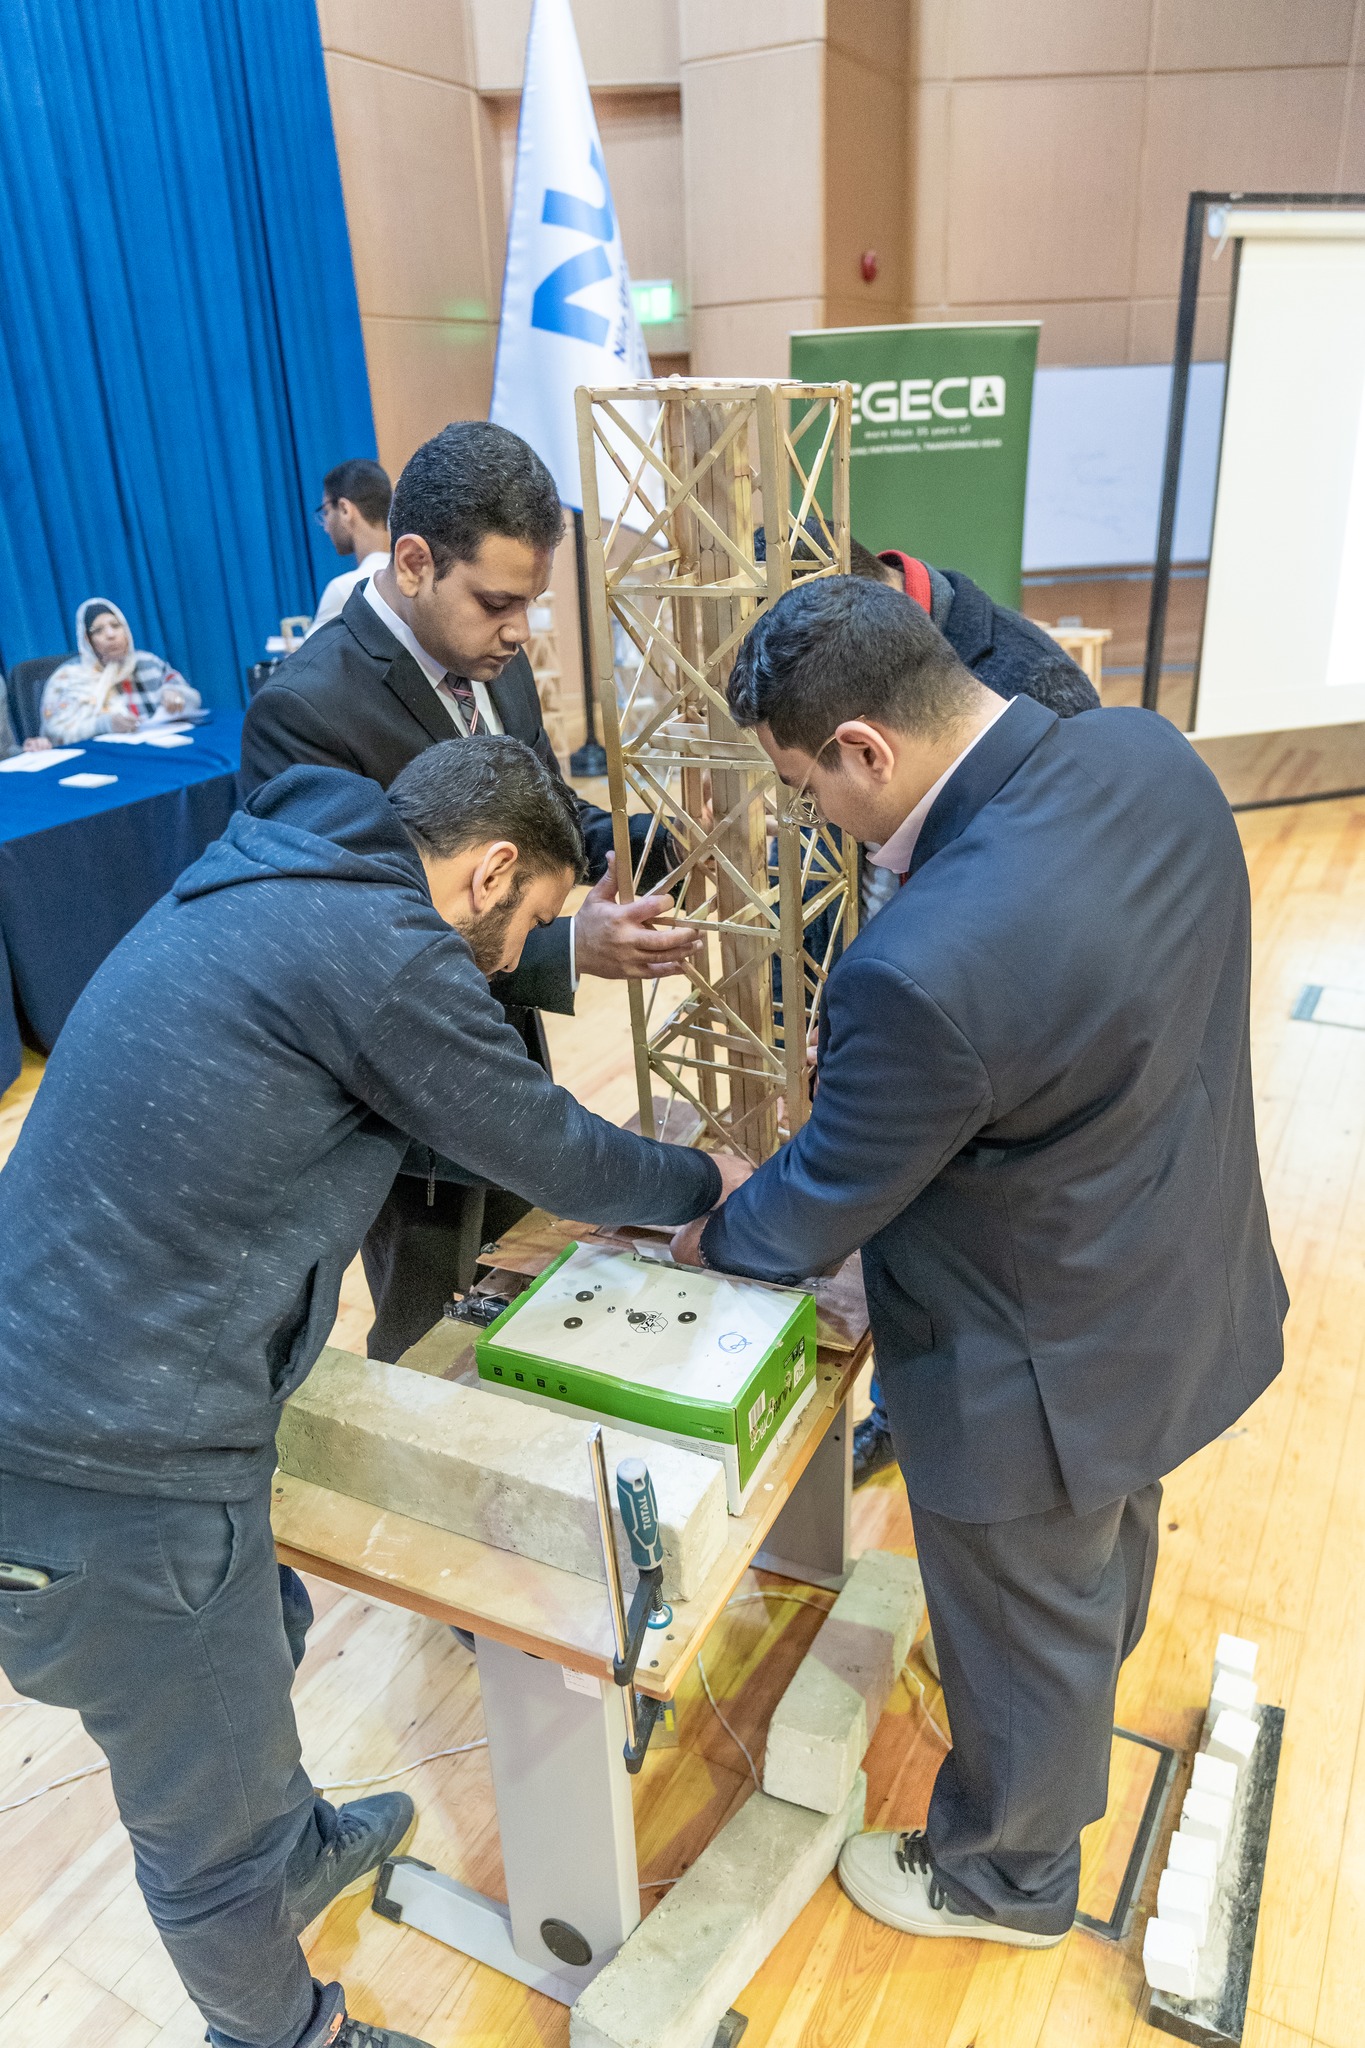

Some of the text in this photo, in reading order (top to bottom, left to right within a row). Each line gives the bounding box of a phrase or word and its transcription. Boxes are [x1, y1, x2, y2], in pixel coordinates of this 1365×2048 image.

[864, 430, 888, 440] more
[890, 428, 914, 438] than
[931, 426, 957, 436] years
[638, 1495, 652, 1531] TOTAL
